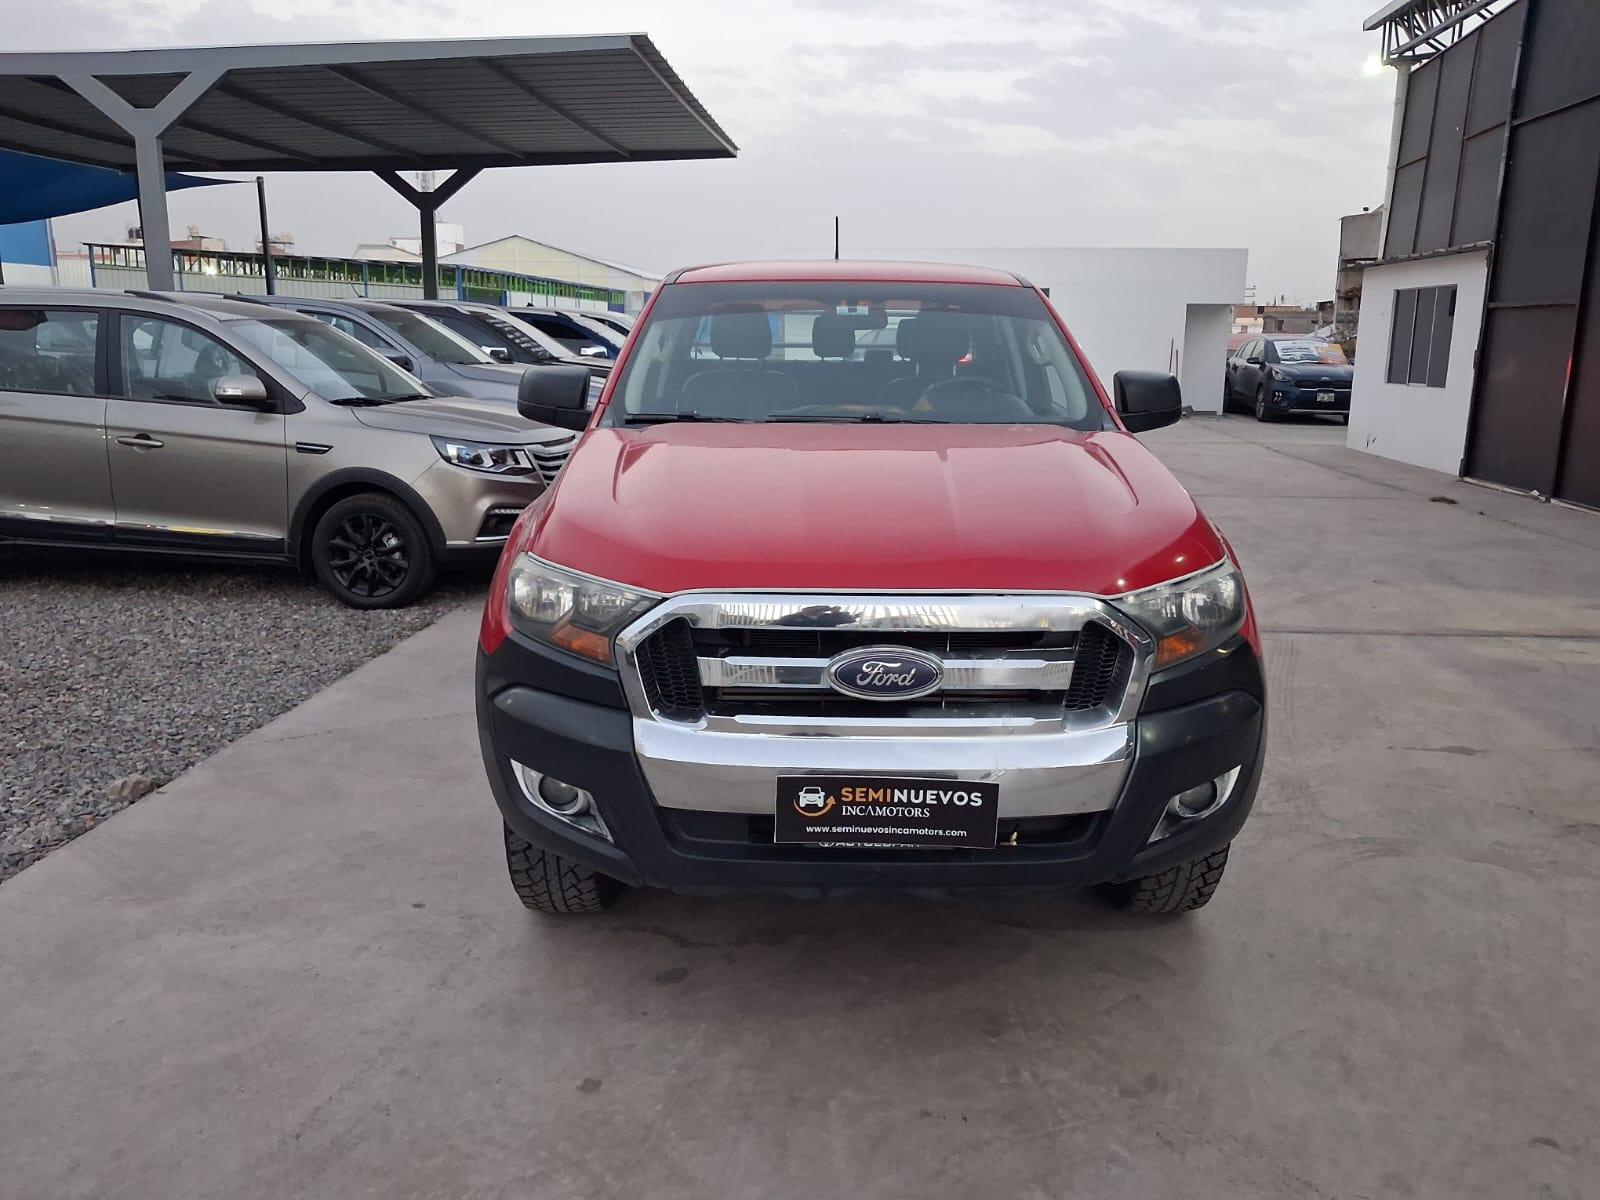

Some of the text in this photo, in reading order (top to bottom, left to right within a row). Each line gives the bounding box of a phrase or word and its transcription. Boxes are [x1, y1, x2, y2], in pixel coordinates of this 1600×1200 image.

[856, 660, 916, 686] Ford
[840, 787, 983, 807] SEMINUEVOS
[841, 805, 930, 818] INCAMOTORS
[806, 824, 967, 837] www.seminuevosincamotors.com
